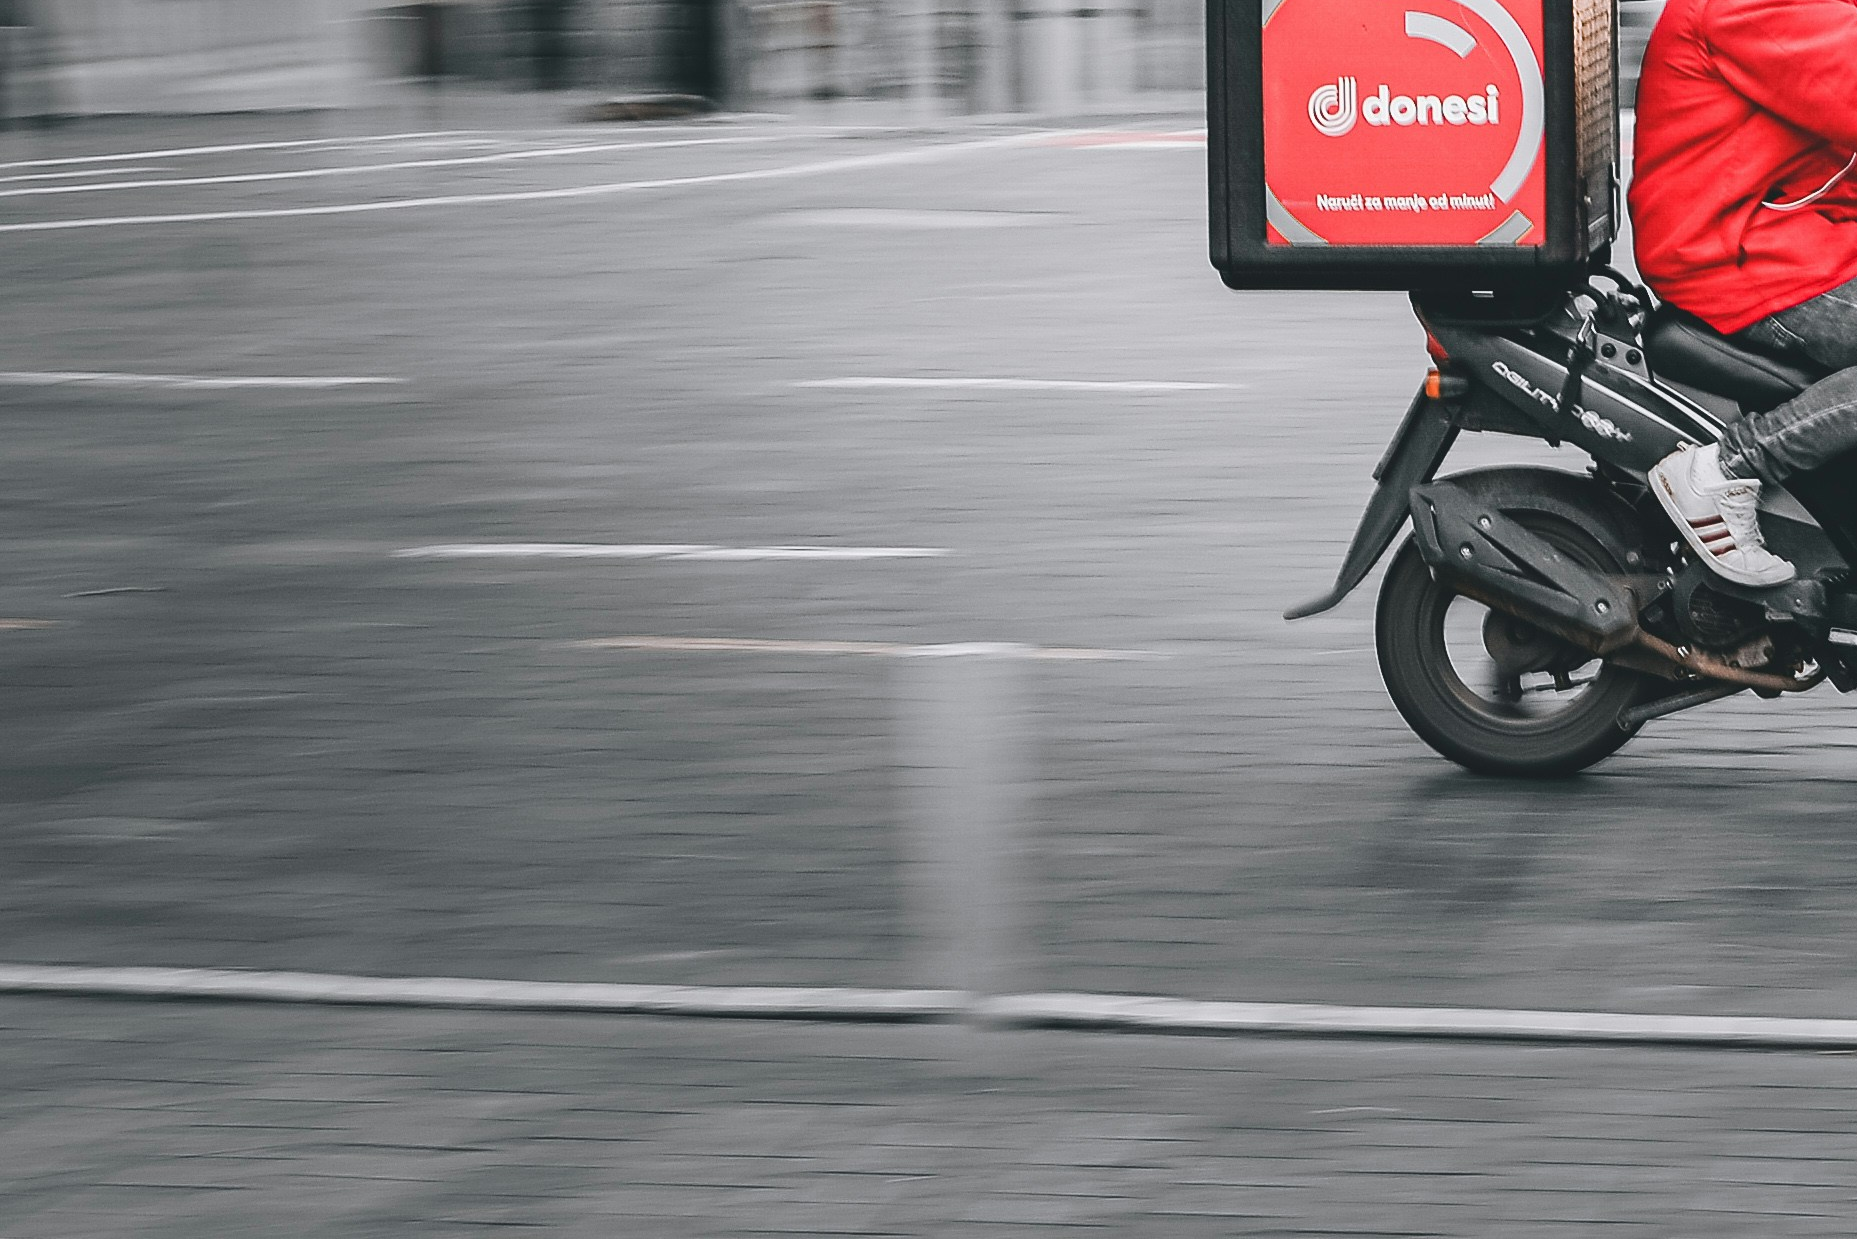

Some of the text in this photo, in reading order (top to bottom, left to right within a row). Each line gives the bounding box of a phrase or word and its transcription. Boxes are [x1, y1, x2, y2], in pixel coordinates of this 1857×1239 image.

[1362, 84, 1499, 126] donesi
[1364, 197, 1383, 211] za
[1383, 193, 1428, 214] manje
[1428, 193, 1450, 211] od
